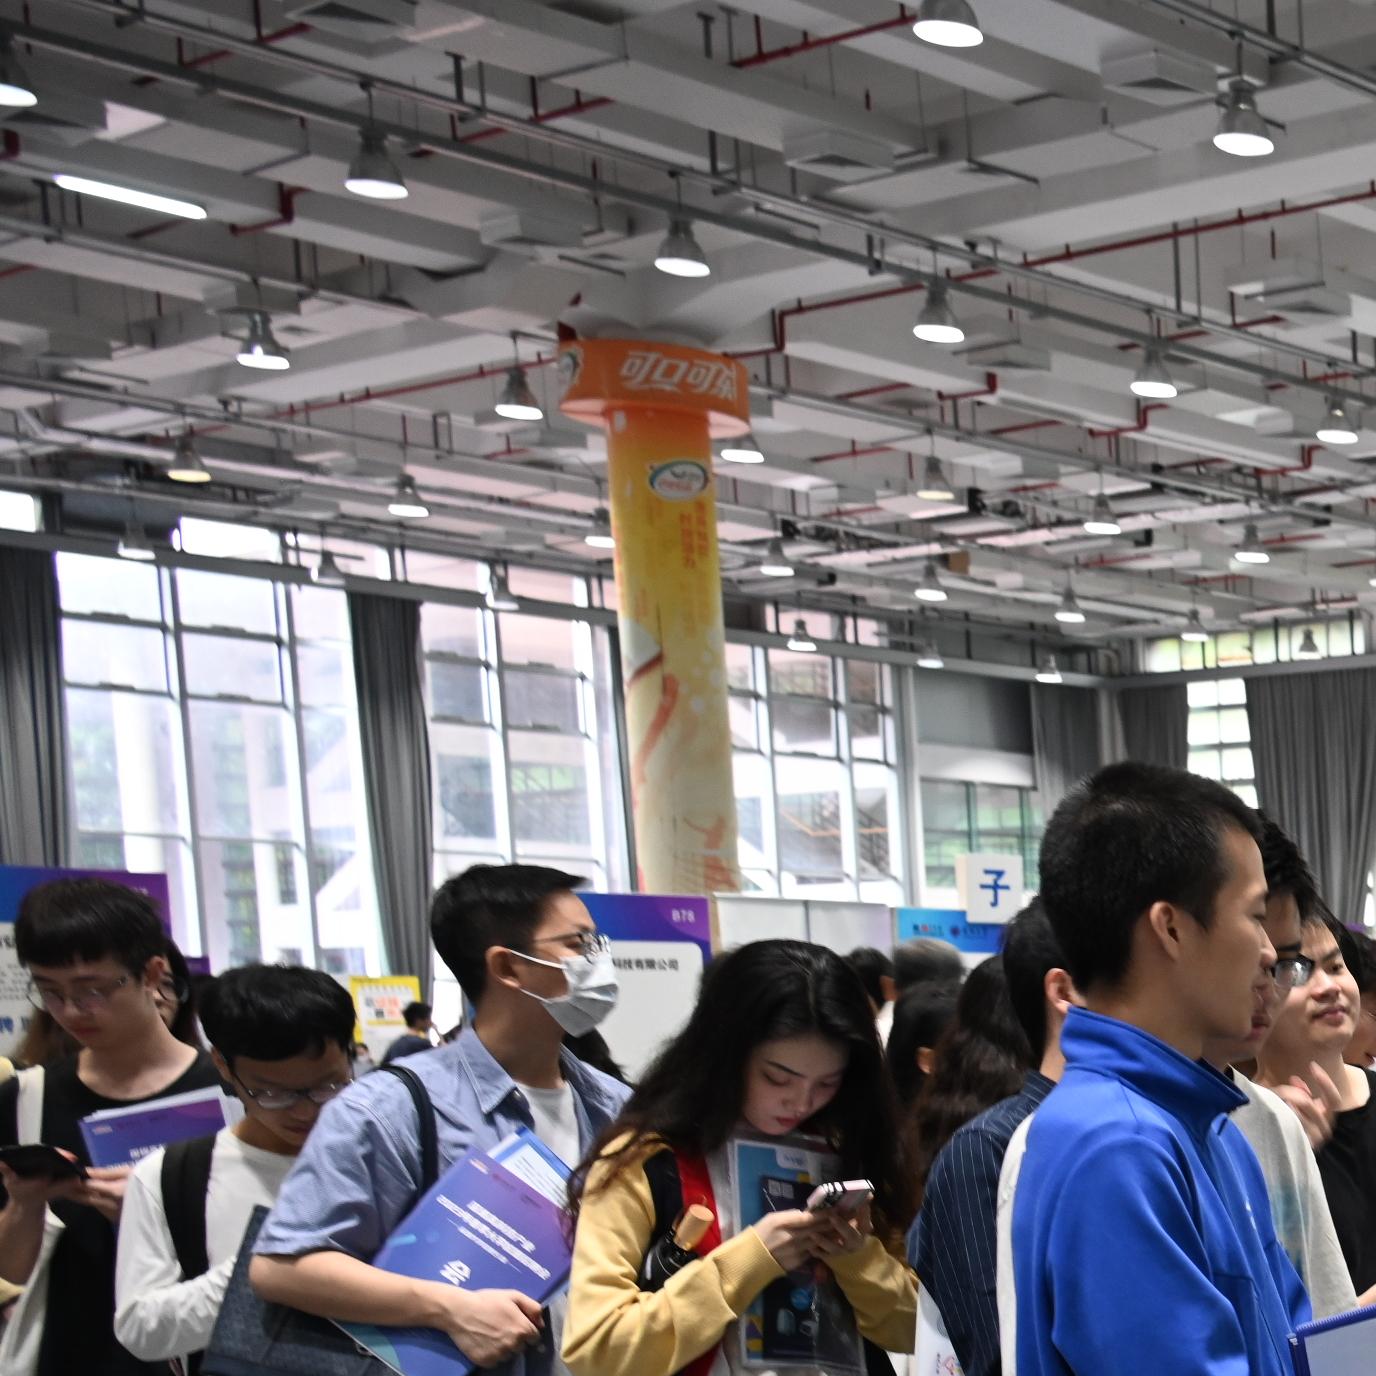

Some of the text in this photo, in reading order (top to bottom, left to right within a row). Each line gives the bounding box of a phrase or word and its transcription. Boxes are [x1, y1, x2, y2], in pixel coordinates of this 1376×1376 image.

[620, 351, 738, 399] 可口可乐
[979, 869, 1010, 908] 子
